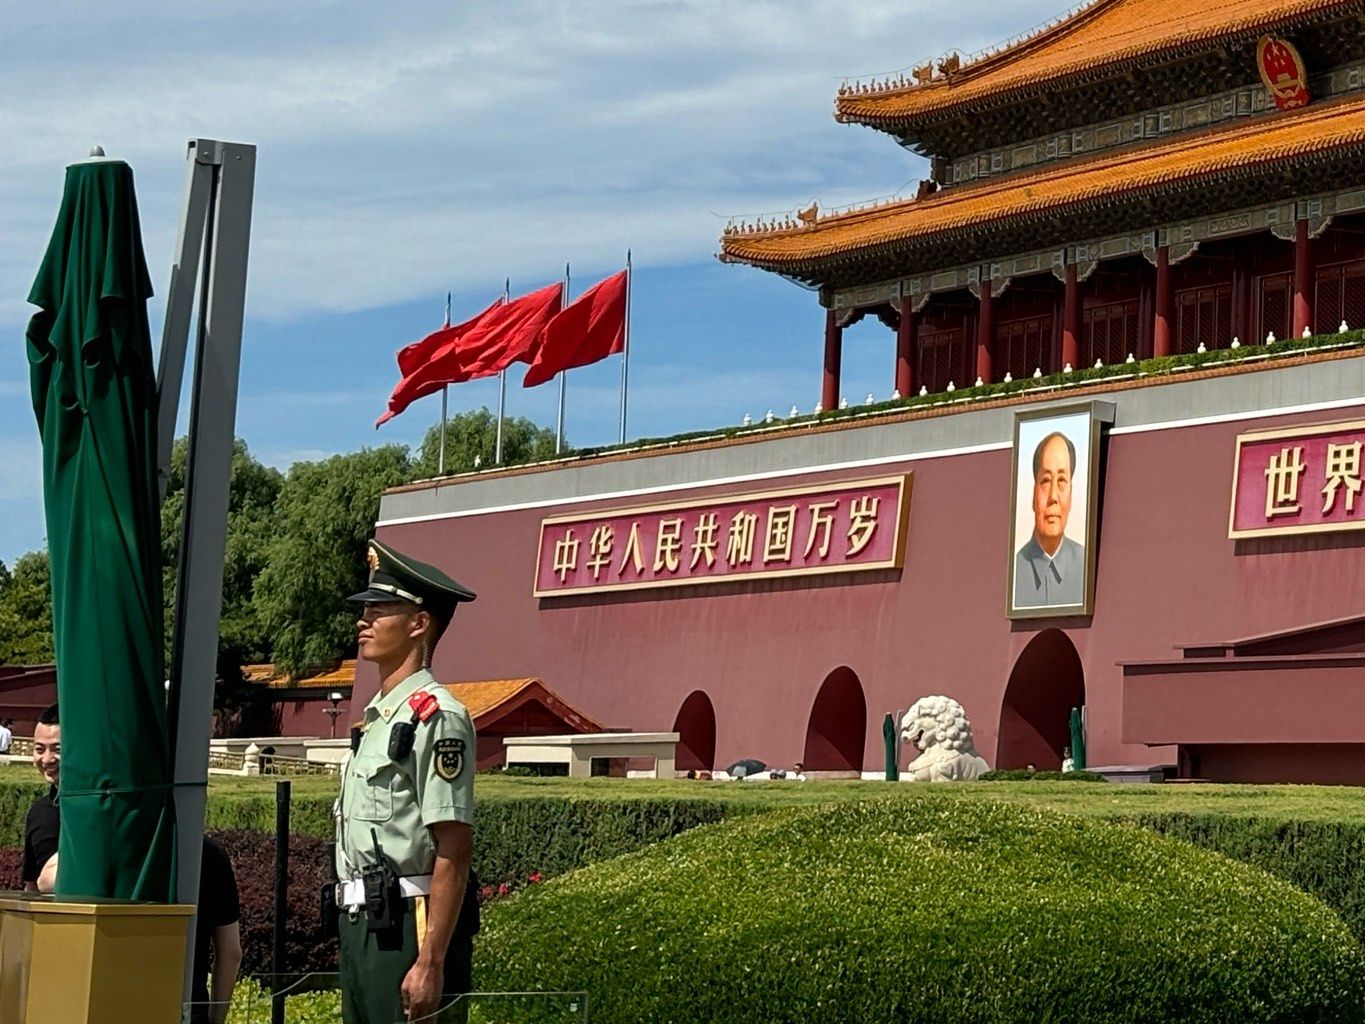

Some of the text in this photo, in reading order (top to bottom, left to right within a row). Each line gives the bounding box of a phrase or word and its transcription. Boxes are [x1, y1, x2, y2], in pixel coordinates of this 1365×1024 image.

[553, 495, 881, 585] 中华人民共和国万岁
